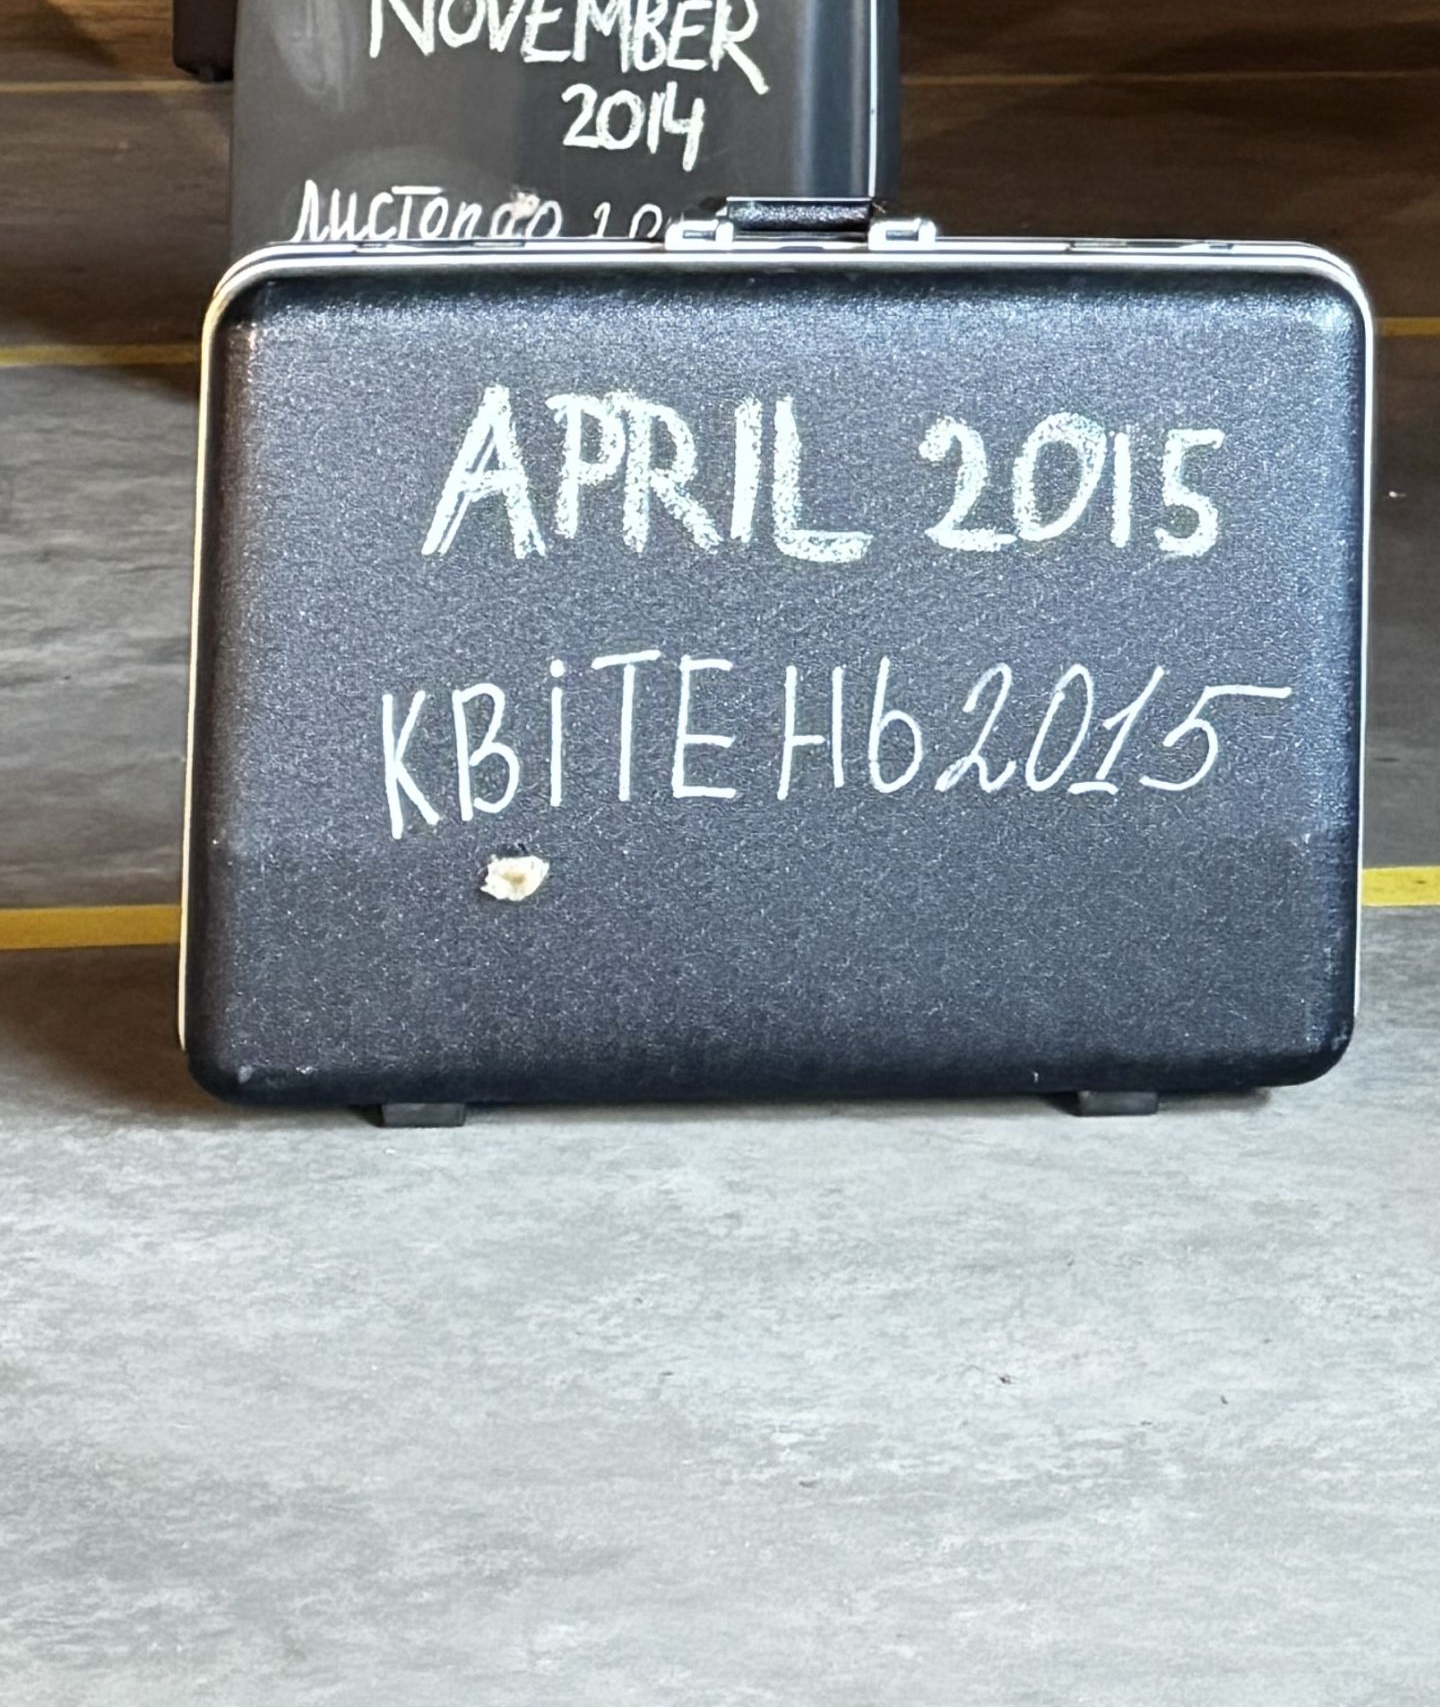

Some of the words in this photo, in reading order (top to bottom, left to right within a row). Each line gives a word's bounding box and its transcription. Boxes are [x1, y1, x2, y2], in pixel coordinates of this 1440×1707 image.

[562, 81, 704, 171] 2014
[420, 385, 873, 563] APRIL
[917, 411, 1227, 560] 2015
